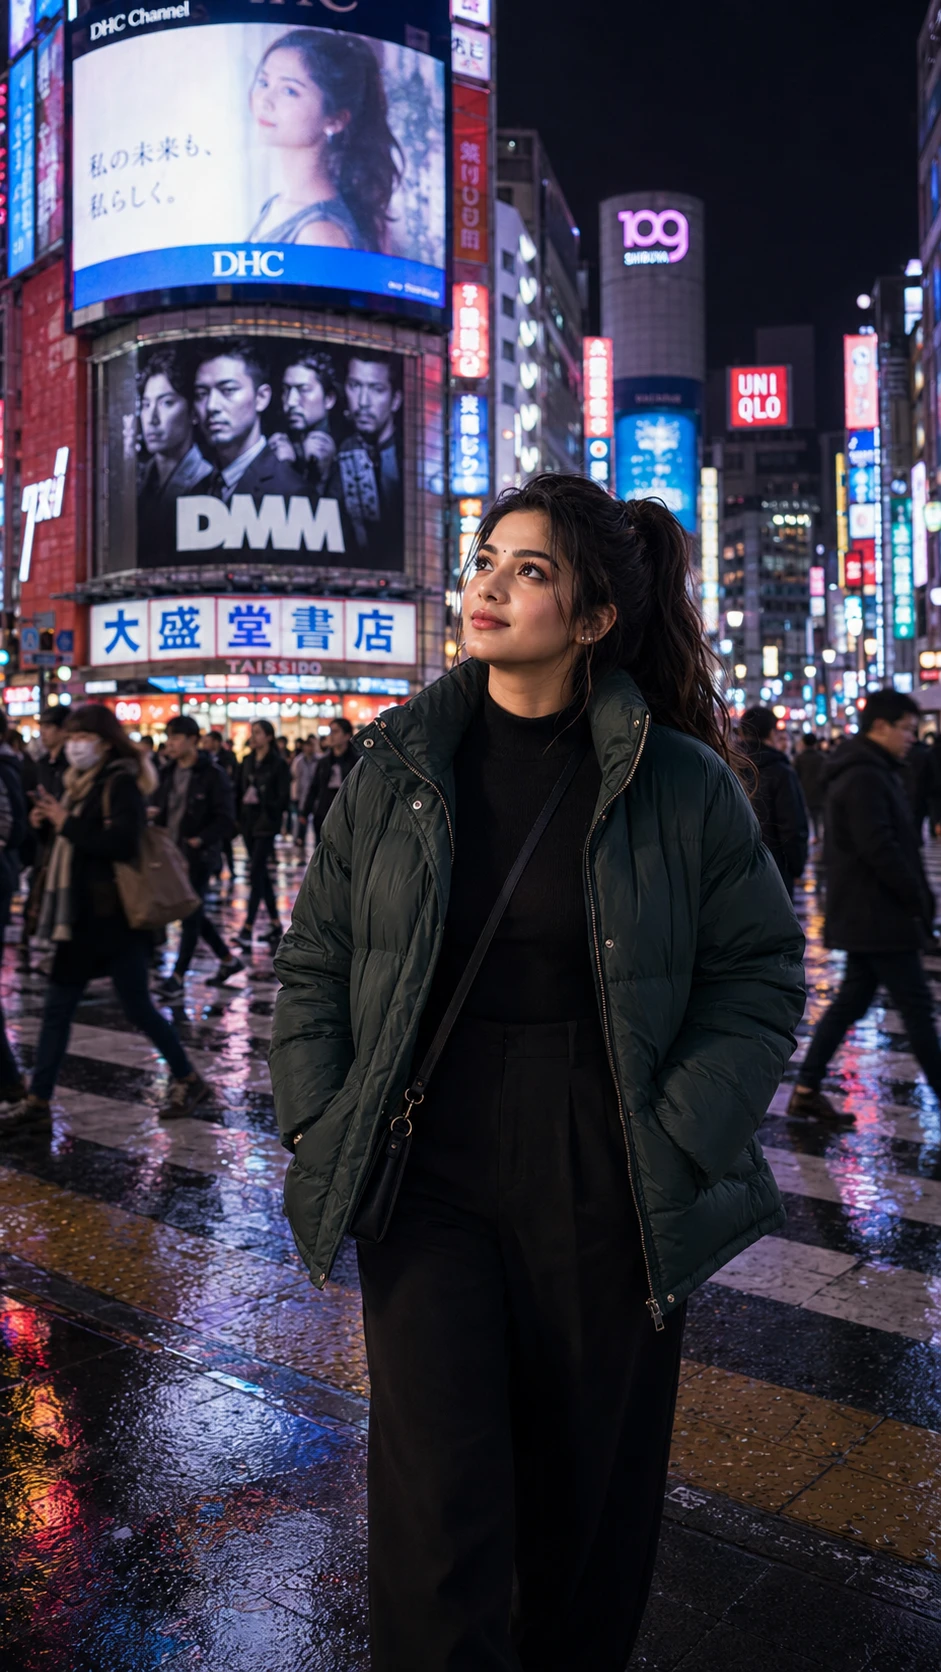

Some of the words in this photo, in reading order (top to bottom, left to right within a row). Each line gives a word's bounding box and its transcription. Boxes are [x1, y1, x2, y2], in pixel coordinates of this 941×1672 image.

[90, 13, 126, 41] DHC
[128, 0, 190, 27] Channel
[90, 133, 212, 179] 私の未来も、
[90, 181, 176, 220] 私らしく。
[618, 209, 689, 263] 109
[212, 250, 285, 278] DHC
[738, 372, 778, 397] UNI
[737, 395, 781, 424] QLO
[176, 494, 346, 554] DMM
[104, 604, 396, 655] 大盛堂書店
[226, 658, 323, 676] TAISSIDO
